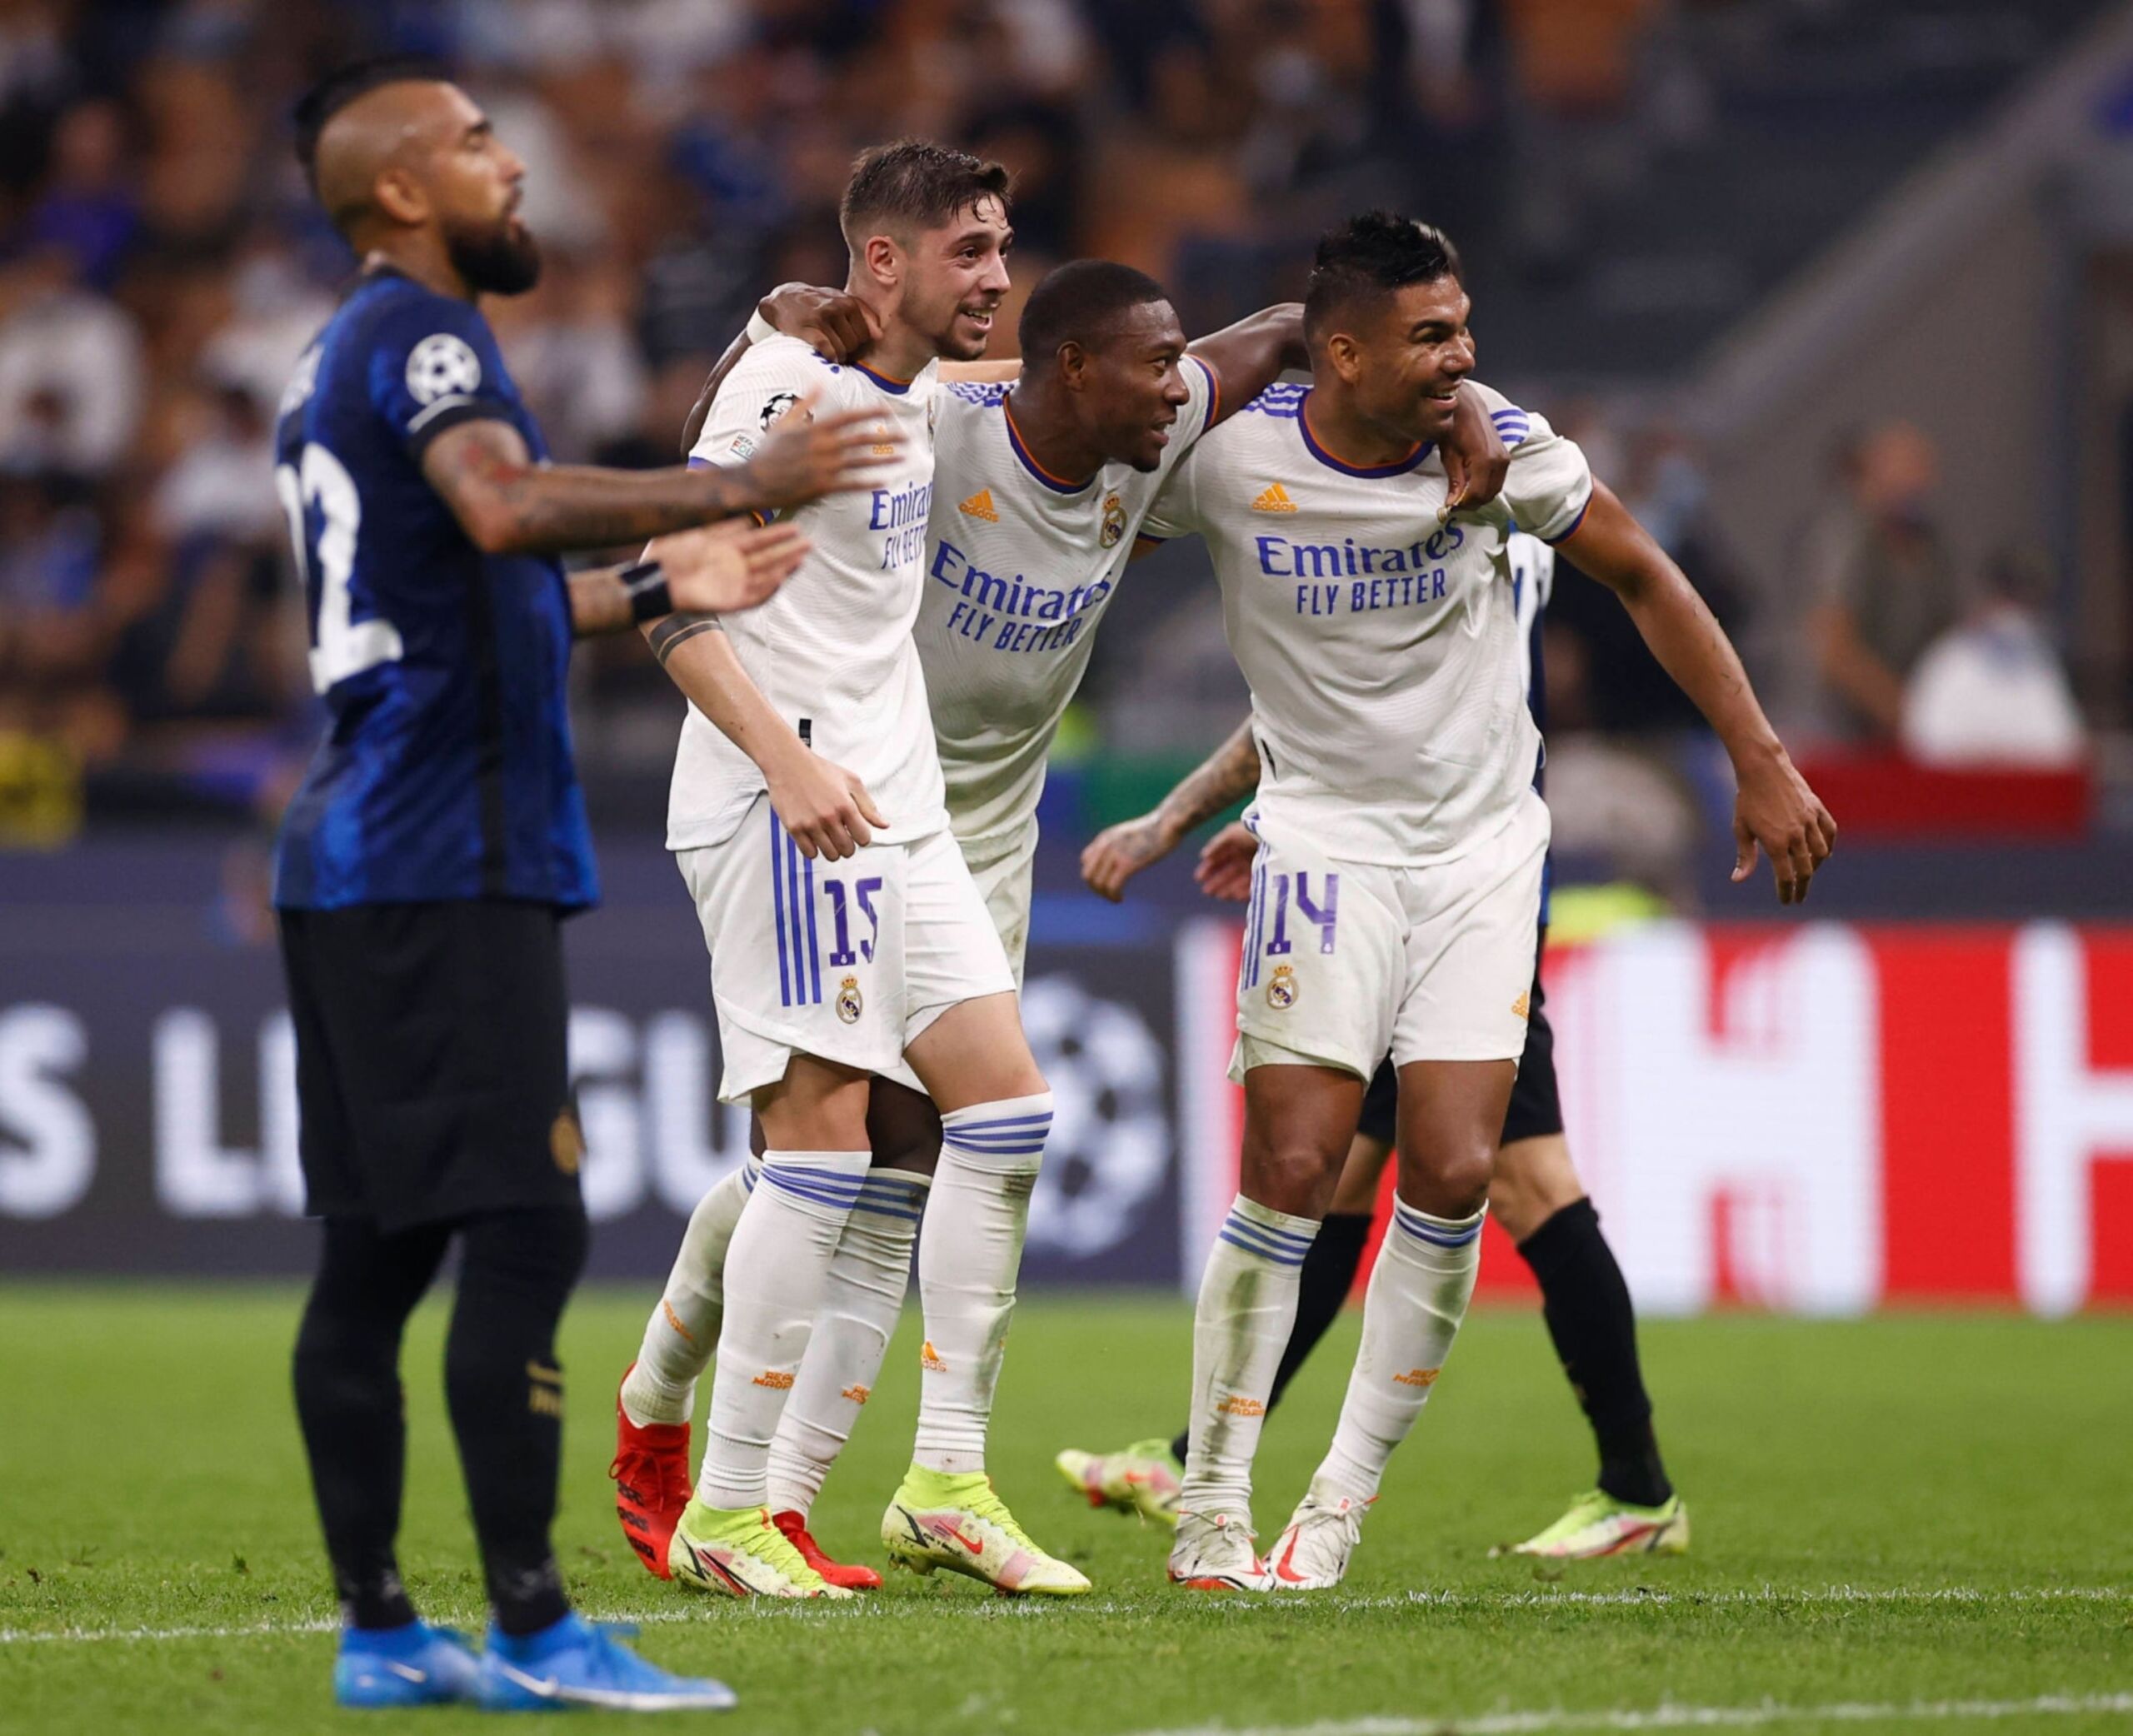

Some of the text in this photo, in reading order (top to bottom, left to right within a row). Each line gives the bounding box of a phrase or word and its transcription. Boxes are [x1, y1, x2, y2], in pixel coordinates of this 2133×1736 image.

[958, 501, 999, 523] adidas
[1251, 501, 1299, 513] adidas
[1254, 516, 1465, 578] Emirates
[930, 539, 1112, 621] Emirates
[1296, 566, 1446, 616] FLY BETTER
[947, 601, 1083, 653] FLY BETTER
[823, 875, 882, 967] 15
[1266, 870, 1339, 956] 14
